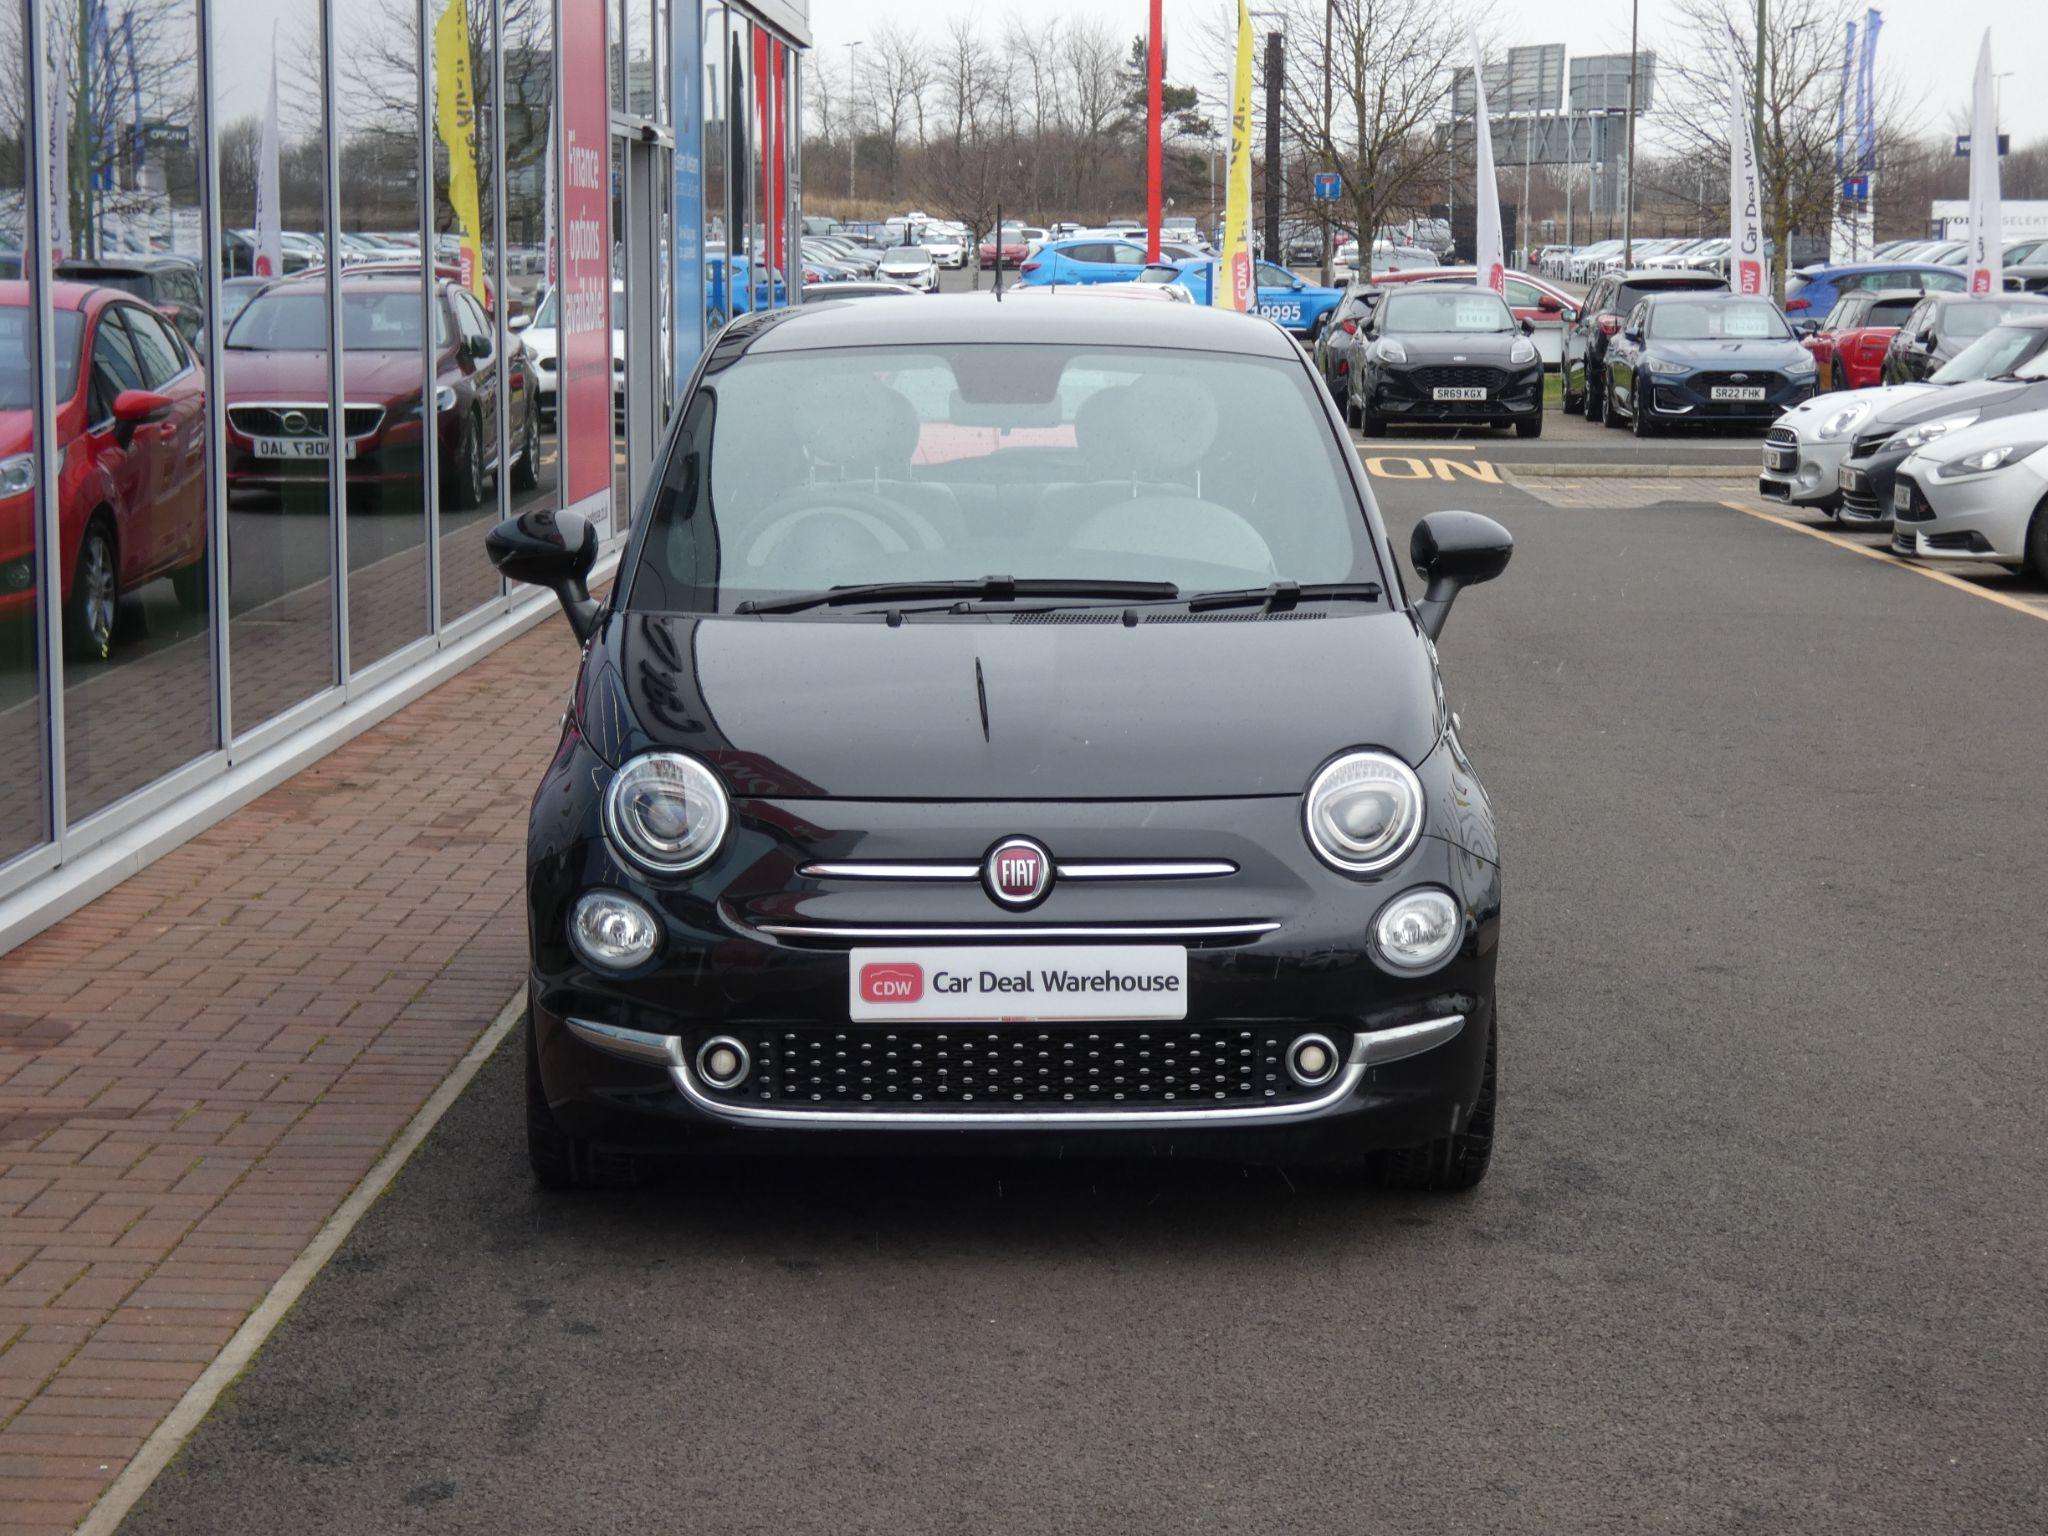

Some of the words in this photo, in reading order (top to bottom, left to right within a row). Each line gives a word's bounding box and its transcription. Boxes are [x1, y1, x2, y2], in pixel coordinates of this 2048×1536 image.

[568, 129, 600, 191] Finance
[1744, 176, 1757, 218] Deal
[569, 204, 600, 277] options
[1741, 222, 1757, 254] Car
[1237, 263, 1247, 300] CDW
[1743, 268, 1755, 293] DW
[566, 276, 605, 335] available!
[1437, 389, 1462, 398] SR69
[1464, 389, 1482, 398] KGX
[1715, 389, 1740, 398] SR22
[1742, 389, 1760, 398] FHK
[1002, 859, 1036, 887] FIAT
[872, 981, 912, 996] CDW
[933, 971, 972, 993] Car
[980, 970, 1034, 993] Deal
[1041, 970, 1180, 992] Warehouse
